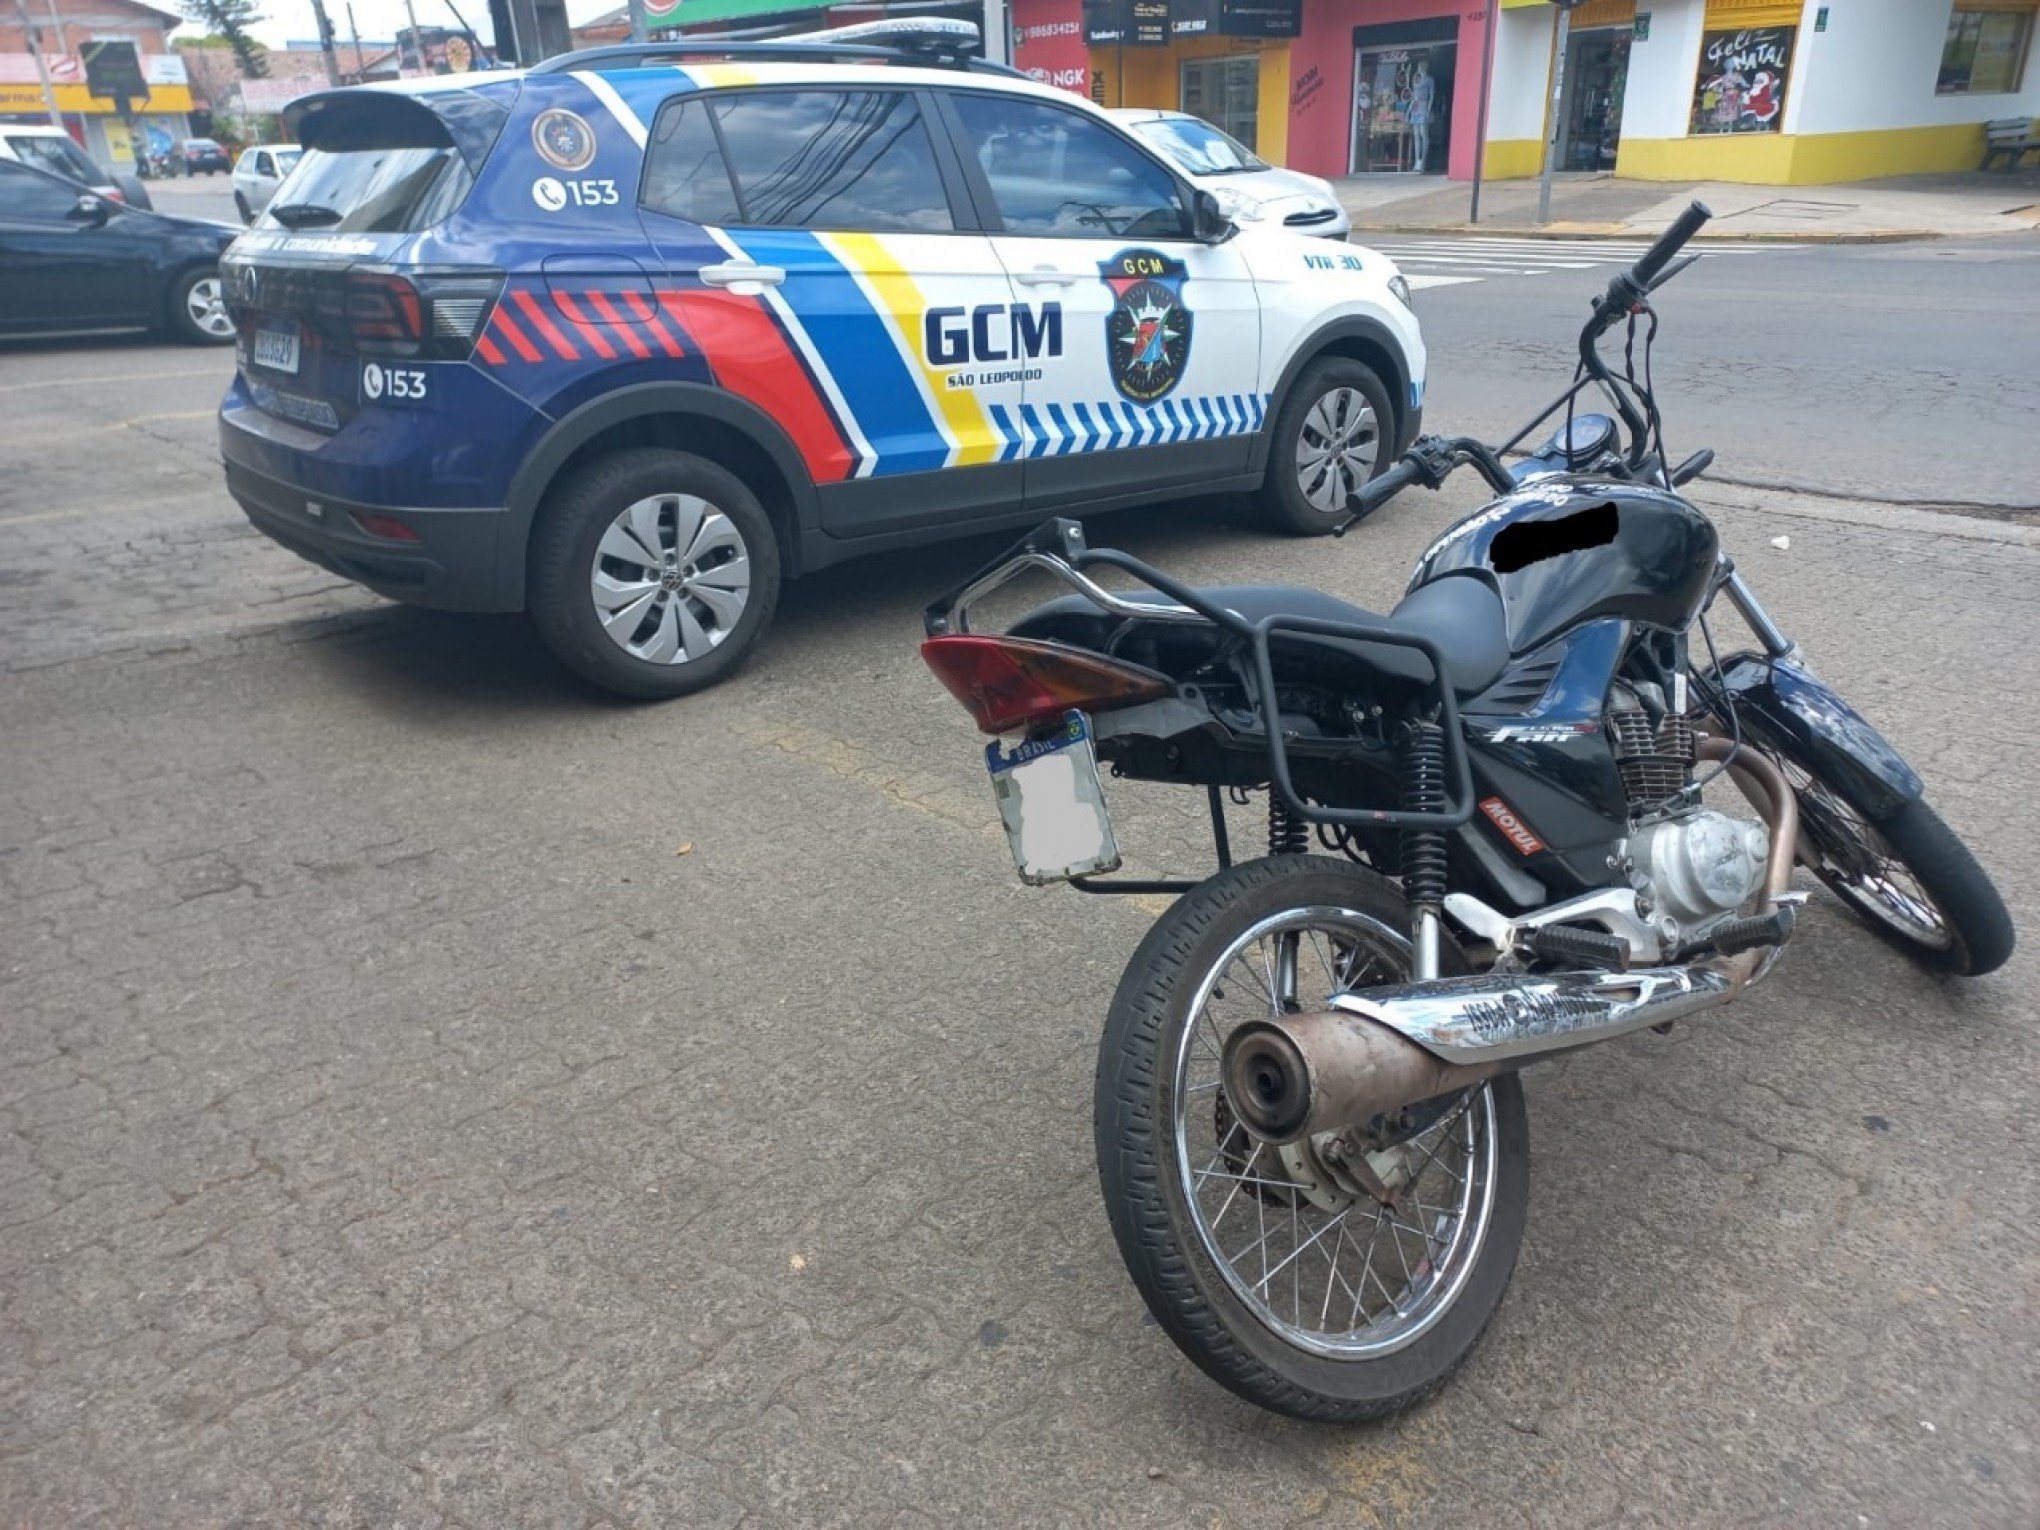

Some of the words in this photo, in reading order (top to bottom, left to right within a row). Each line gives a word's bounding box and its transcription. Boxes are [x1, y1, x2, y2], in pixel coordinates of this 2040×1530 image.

[1053, 66, 1085, 86] NGK
[566, 180, 619, 206] 153
[1123, 257, 1164, 275] GCM
[1303, 254, 1335, 270] VTR
[1337, 254, 1363, 271] 30
[925, 301, 1063, 366] GCM
[384, 369, 427, 399] 153
[947, 372, 975, 388] SÃO
[979, 368, 1042, 385] LEOPOLDO
[1485, 802, 1541, 852] MOTUL
